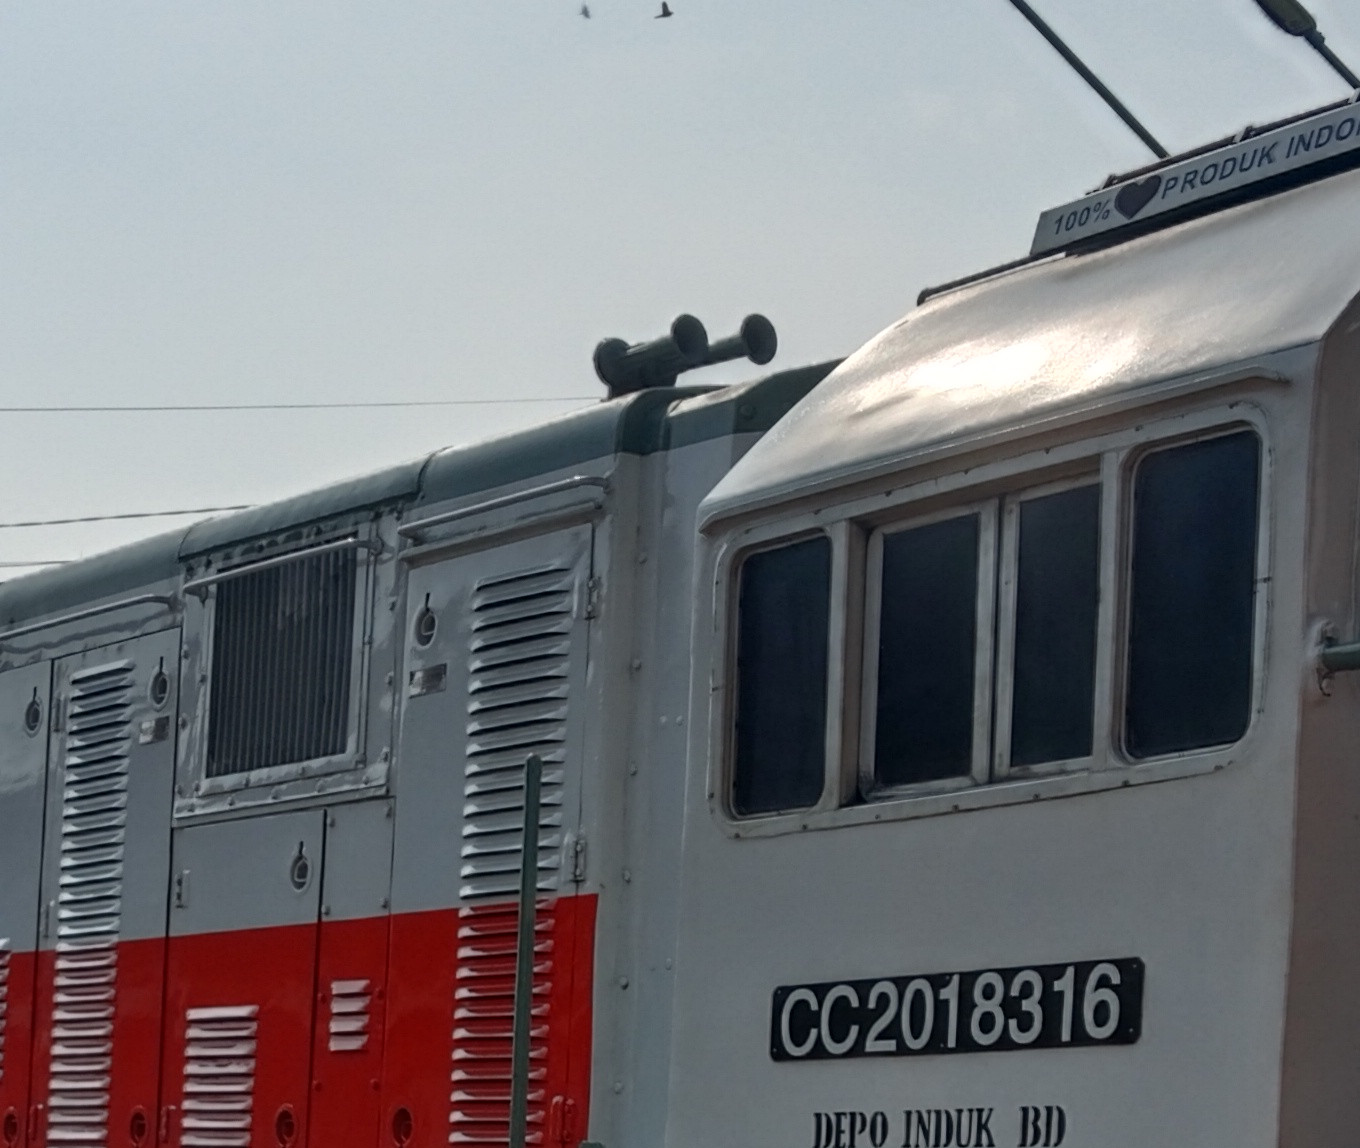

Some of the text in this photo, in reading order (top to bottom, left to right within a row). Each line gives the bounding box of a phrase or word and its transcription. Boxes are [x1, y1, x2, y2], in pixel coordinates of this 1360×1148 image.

[1053, 201, 1112, 235] 100%
[1160, 140, 1281, 201] PRODUK
[780, 961, 1122, 1058] CC2018316
[900, 1107, 996, 1148] INDUK
[1017, 1105, 1067, 1148] BD
